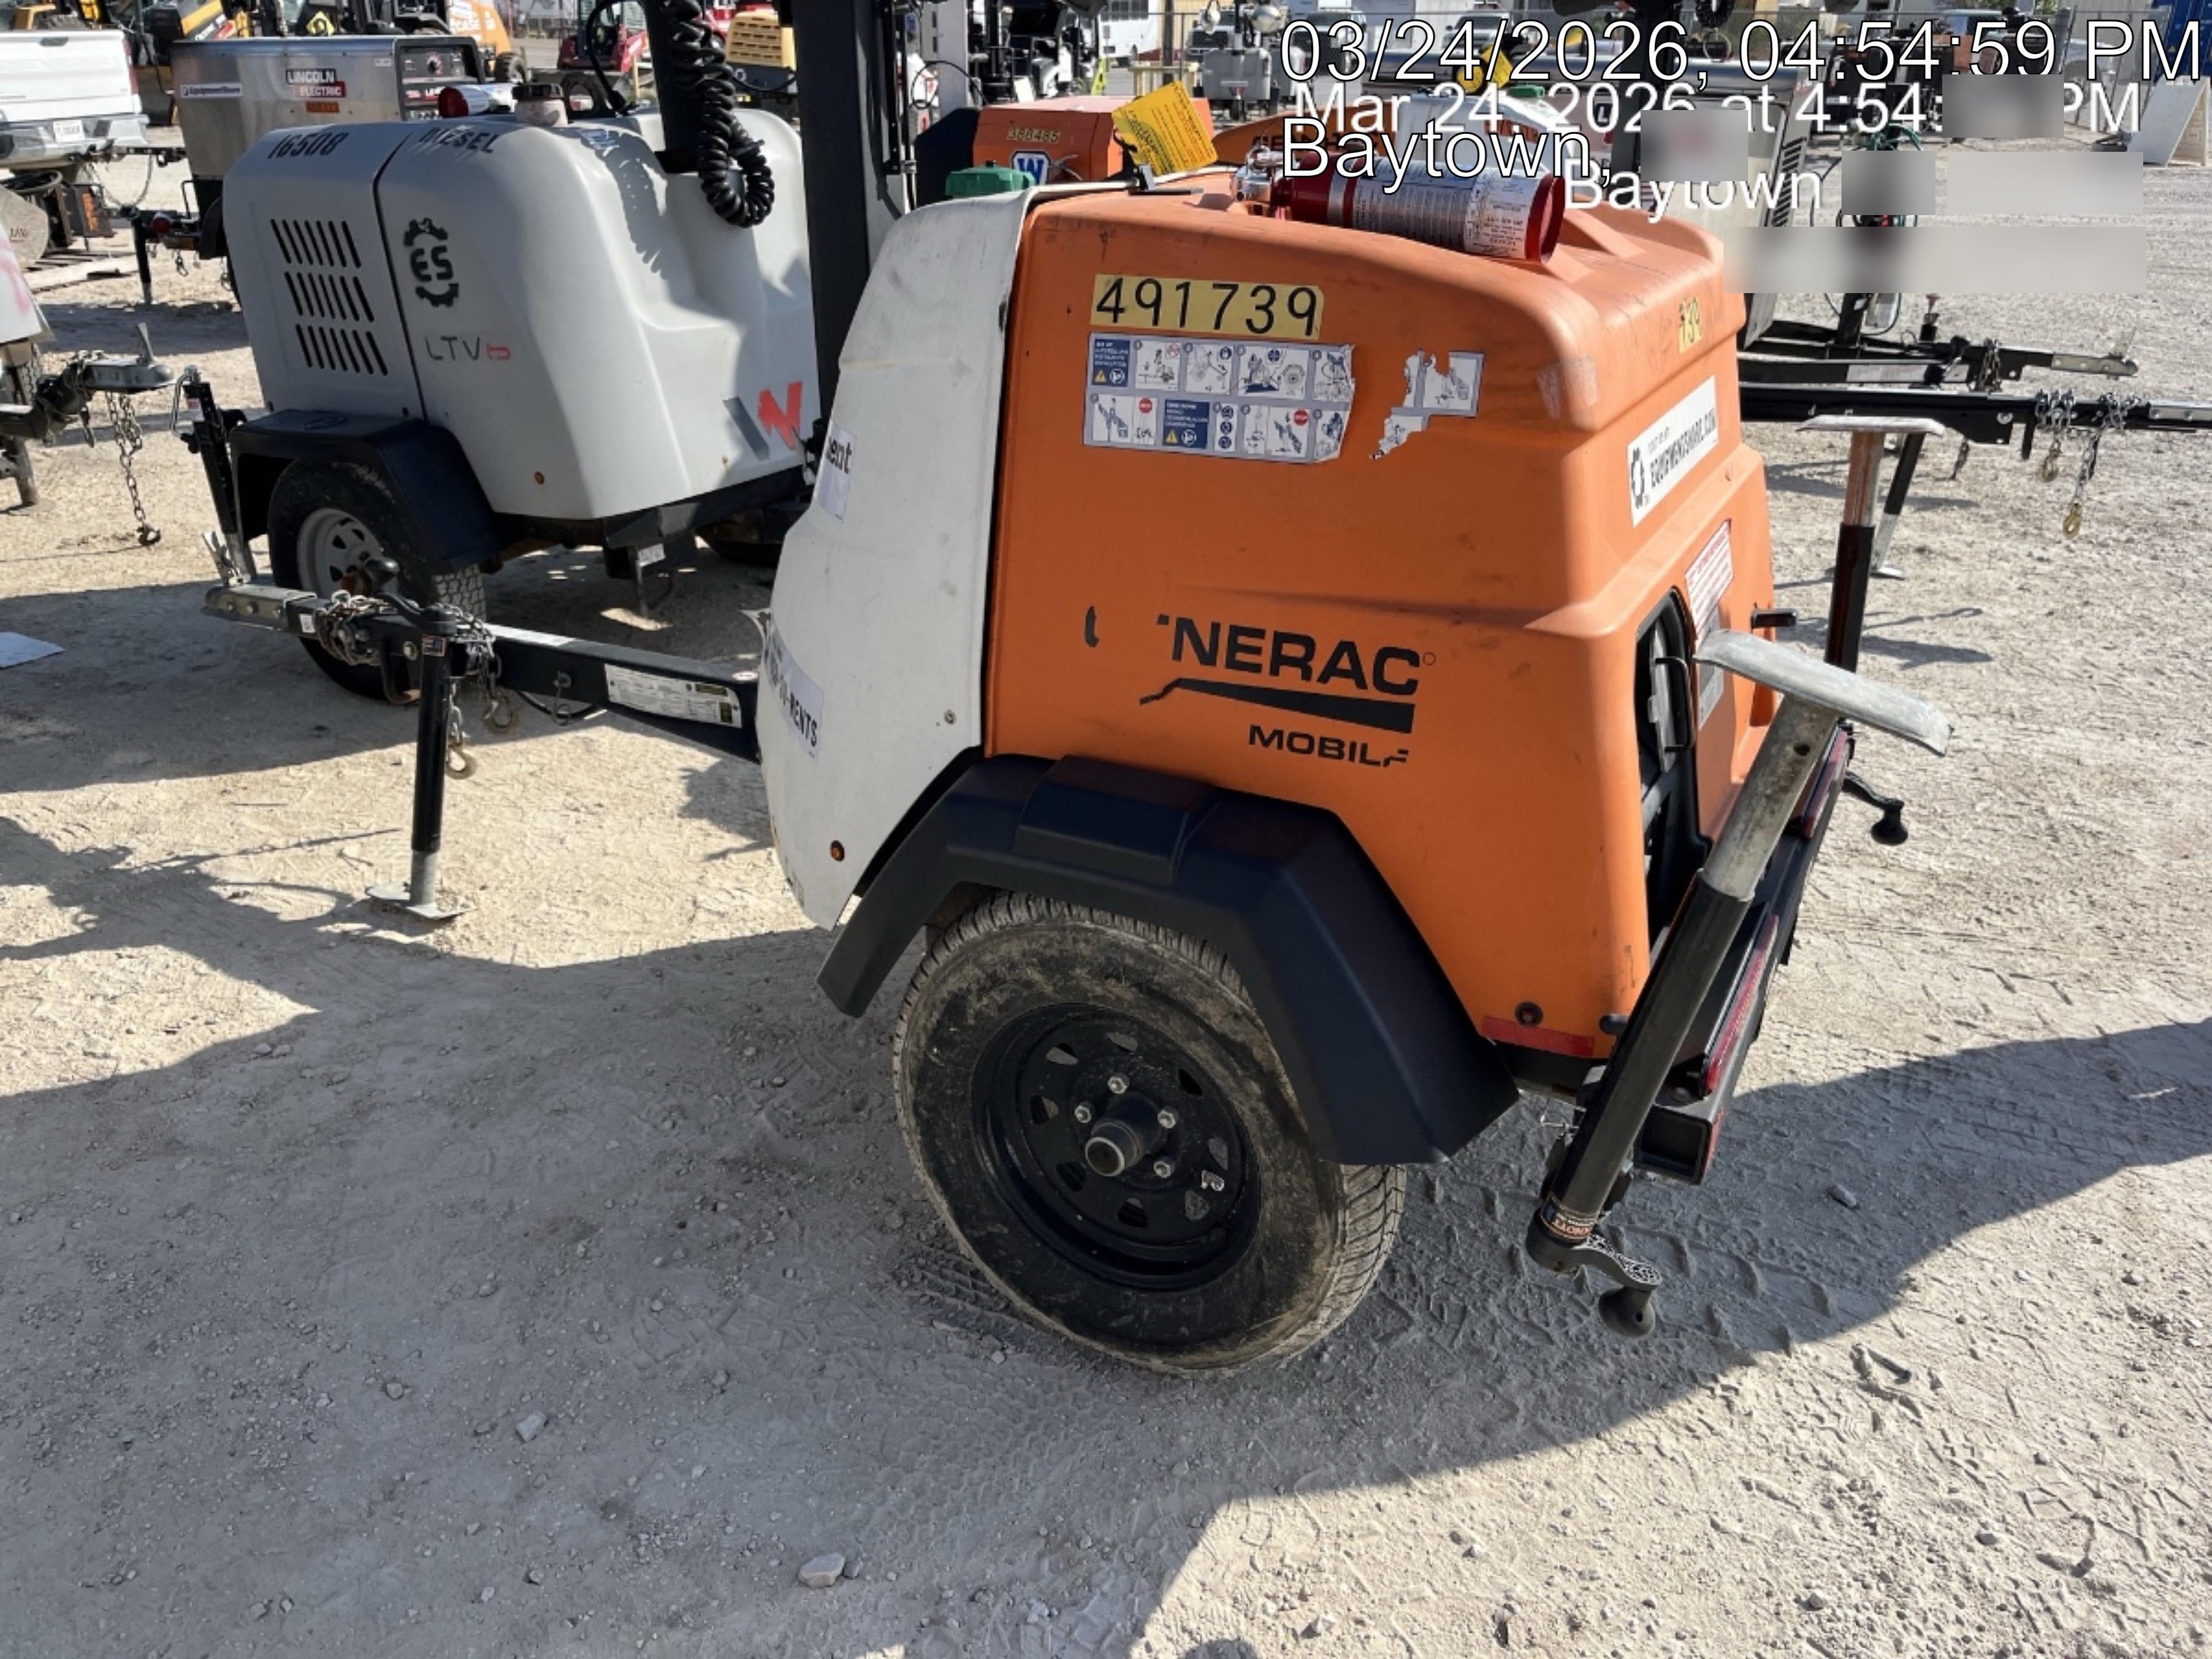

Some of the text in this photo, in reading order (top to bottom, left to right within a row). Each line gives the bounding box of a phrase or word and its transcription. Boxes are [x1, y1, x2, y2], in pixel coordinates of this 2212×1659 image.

[287, 70, 335, 82] LINCOLN
[299, 85, 342, 96] ELECTRIC
[267, 132, 349, 159] 16508
[418, 127, 501, 154] DIESEL
[1096, 277, 1317, 336] 491739
[1157, 613, 1420, 696] NERAC
